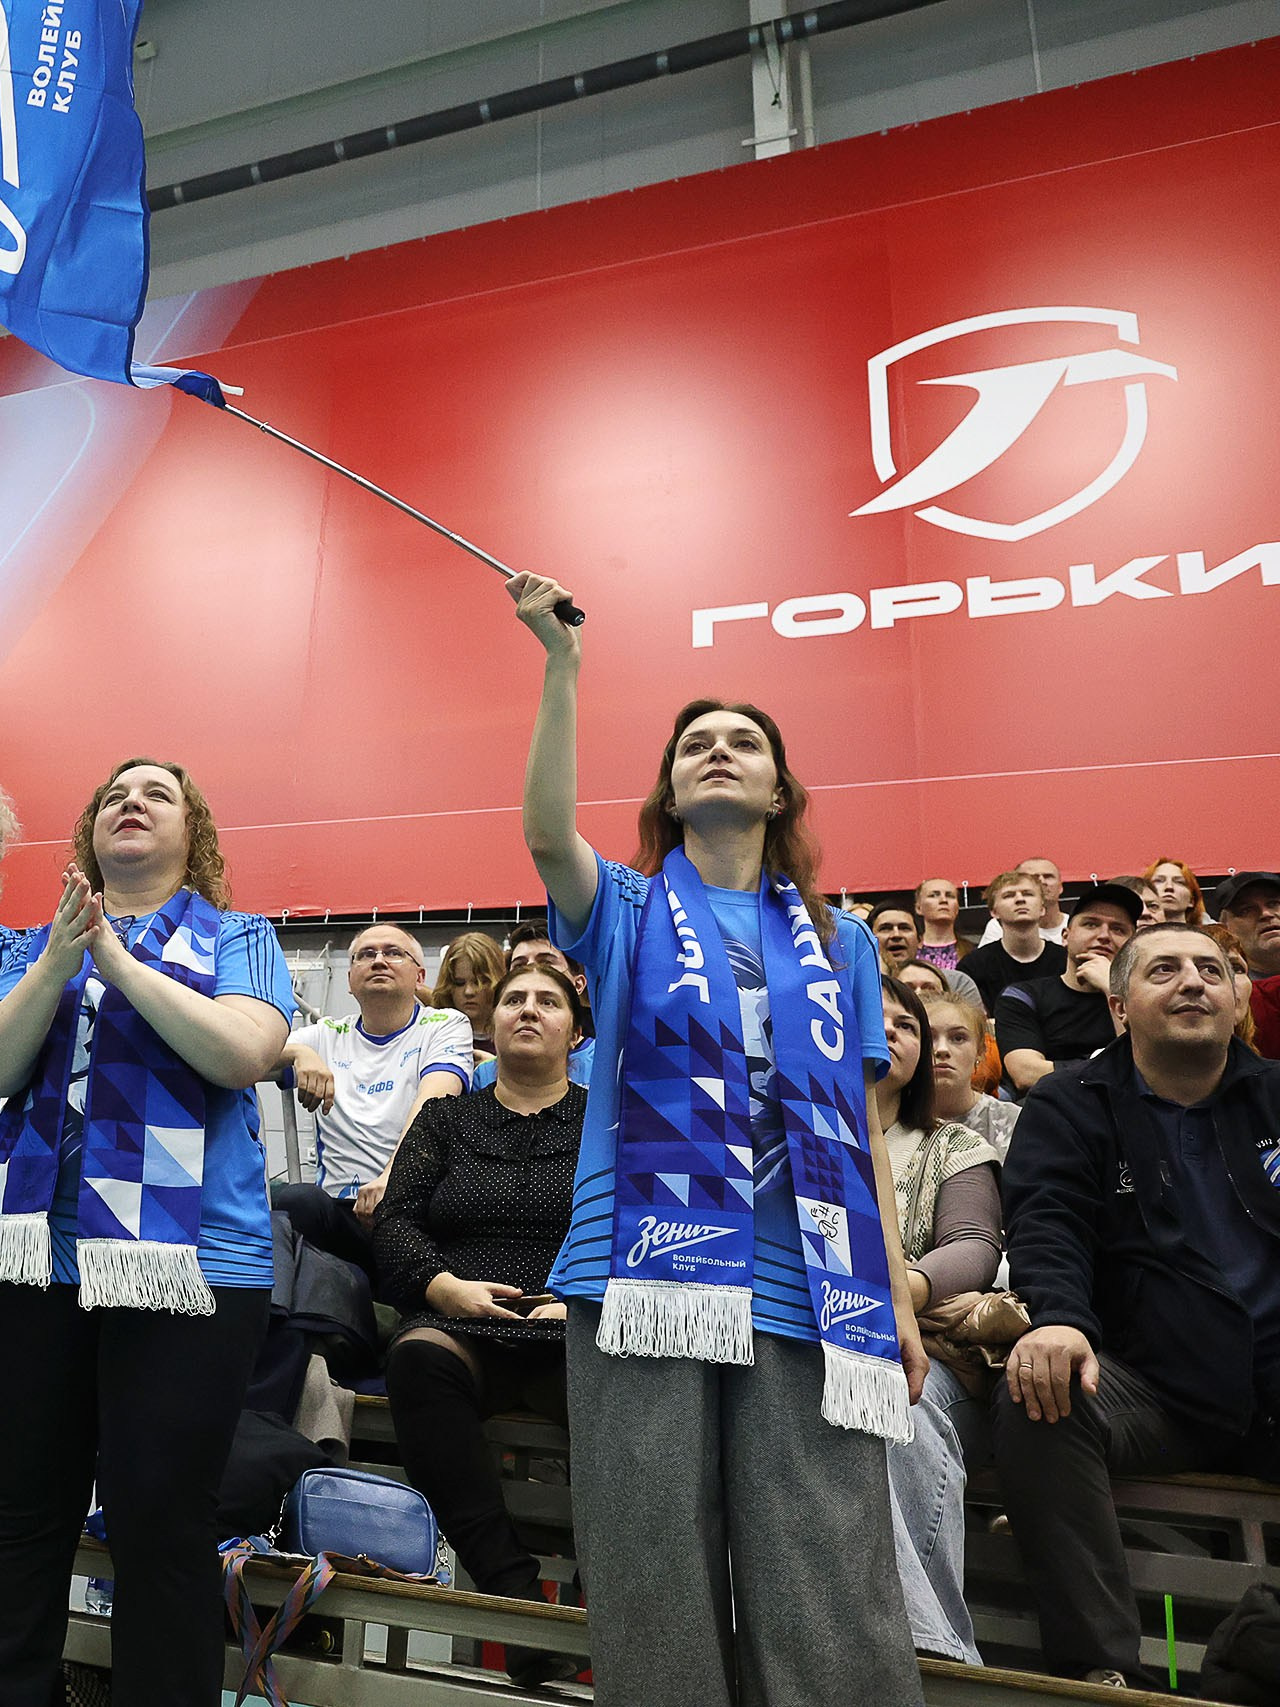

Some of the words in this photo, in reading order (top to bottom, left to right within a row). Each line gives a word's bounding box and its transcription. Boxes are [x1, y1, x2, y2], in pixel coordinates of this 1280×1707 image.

[27, 0, 65, 108] ВОЛЕЙ
[52, 30, 82, 113] КЛУБ
[626, 1215, 740, 1268] Зенит
[672, 1253, 747, 1268] ВОЛЕЙБОЛЬНЫЙ
[672, 1262, 696, 1272] КЛУБ
[820, 1280, 886, 1332] Зенит
[845, 1333, 867, 1344] КЛУБ
